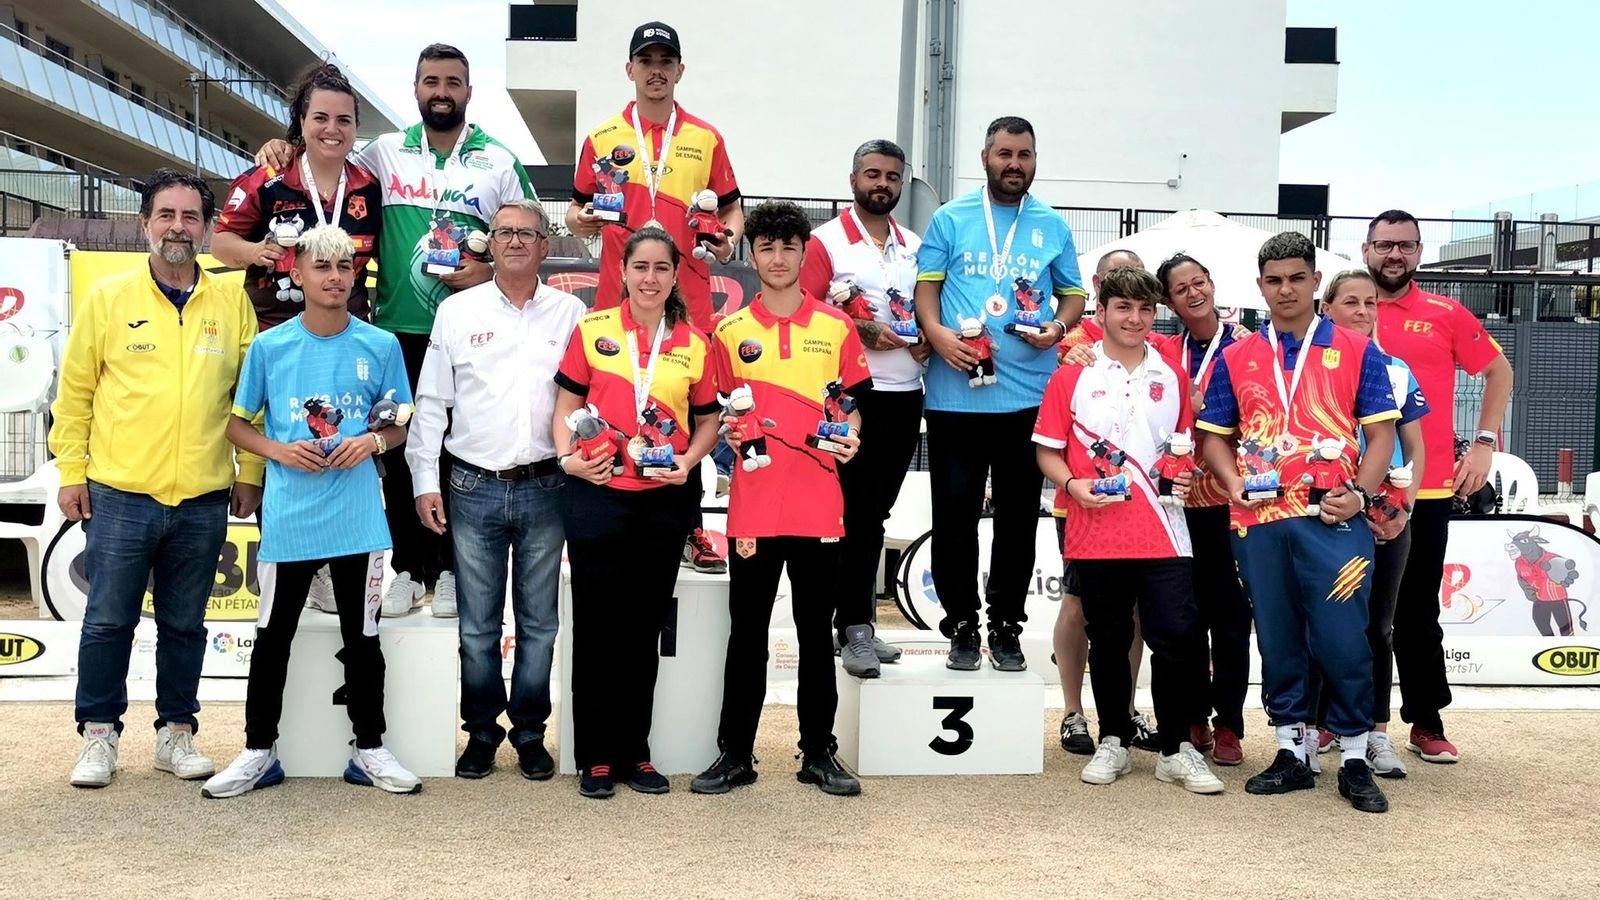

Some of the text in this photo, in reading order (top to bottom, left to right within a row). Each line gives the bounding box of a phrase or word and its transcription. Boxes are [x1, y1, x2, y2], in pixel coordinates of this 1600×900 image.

[388, 173, 482, 215] Anducía
[964, 251, 1040, 269] REIÓN
[964, 263, 1038, 281] MUCIA
[1404, 320, 1432, 332] FEP
[470, 331, 494, 344] FEP
[289, 392, 364, 409] RGIÓN
[290, 408, 362, 423] MIA
[1550, 650, 1599, 669] OBUT
[928, 696, 974, 755] 3
